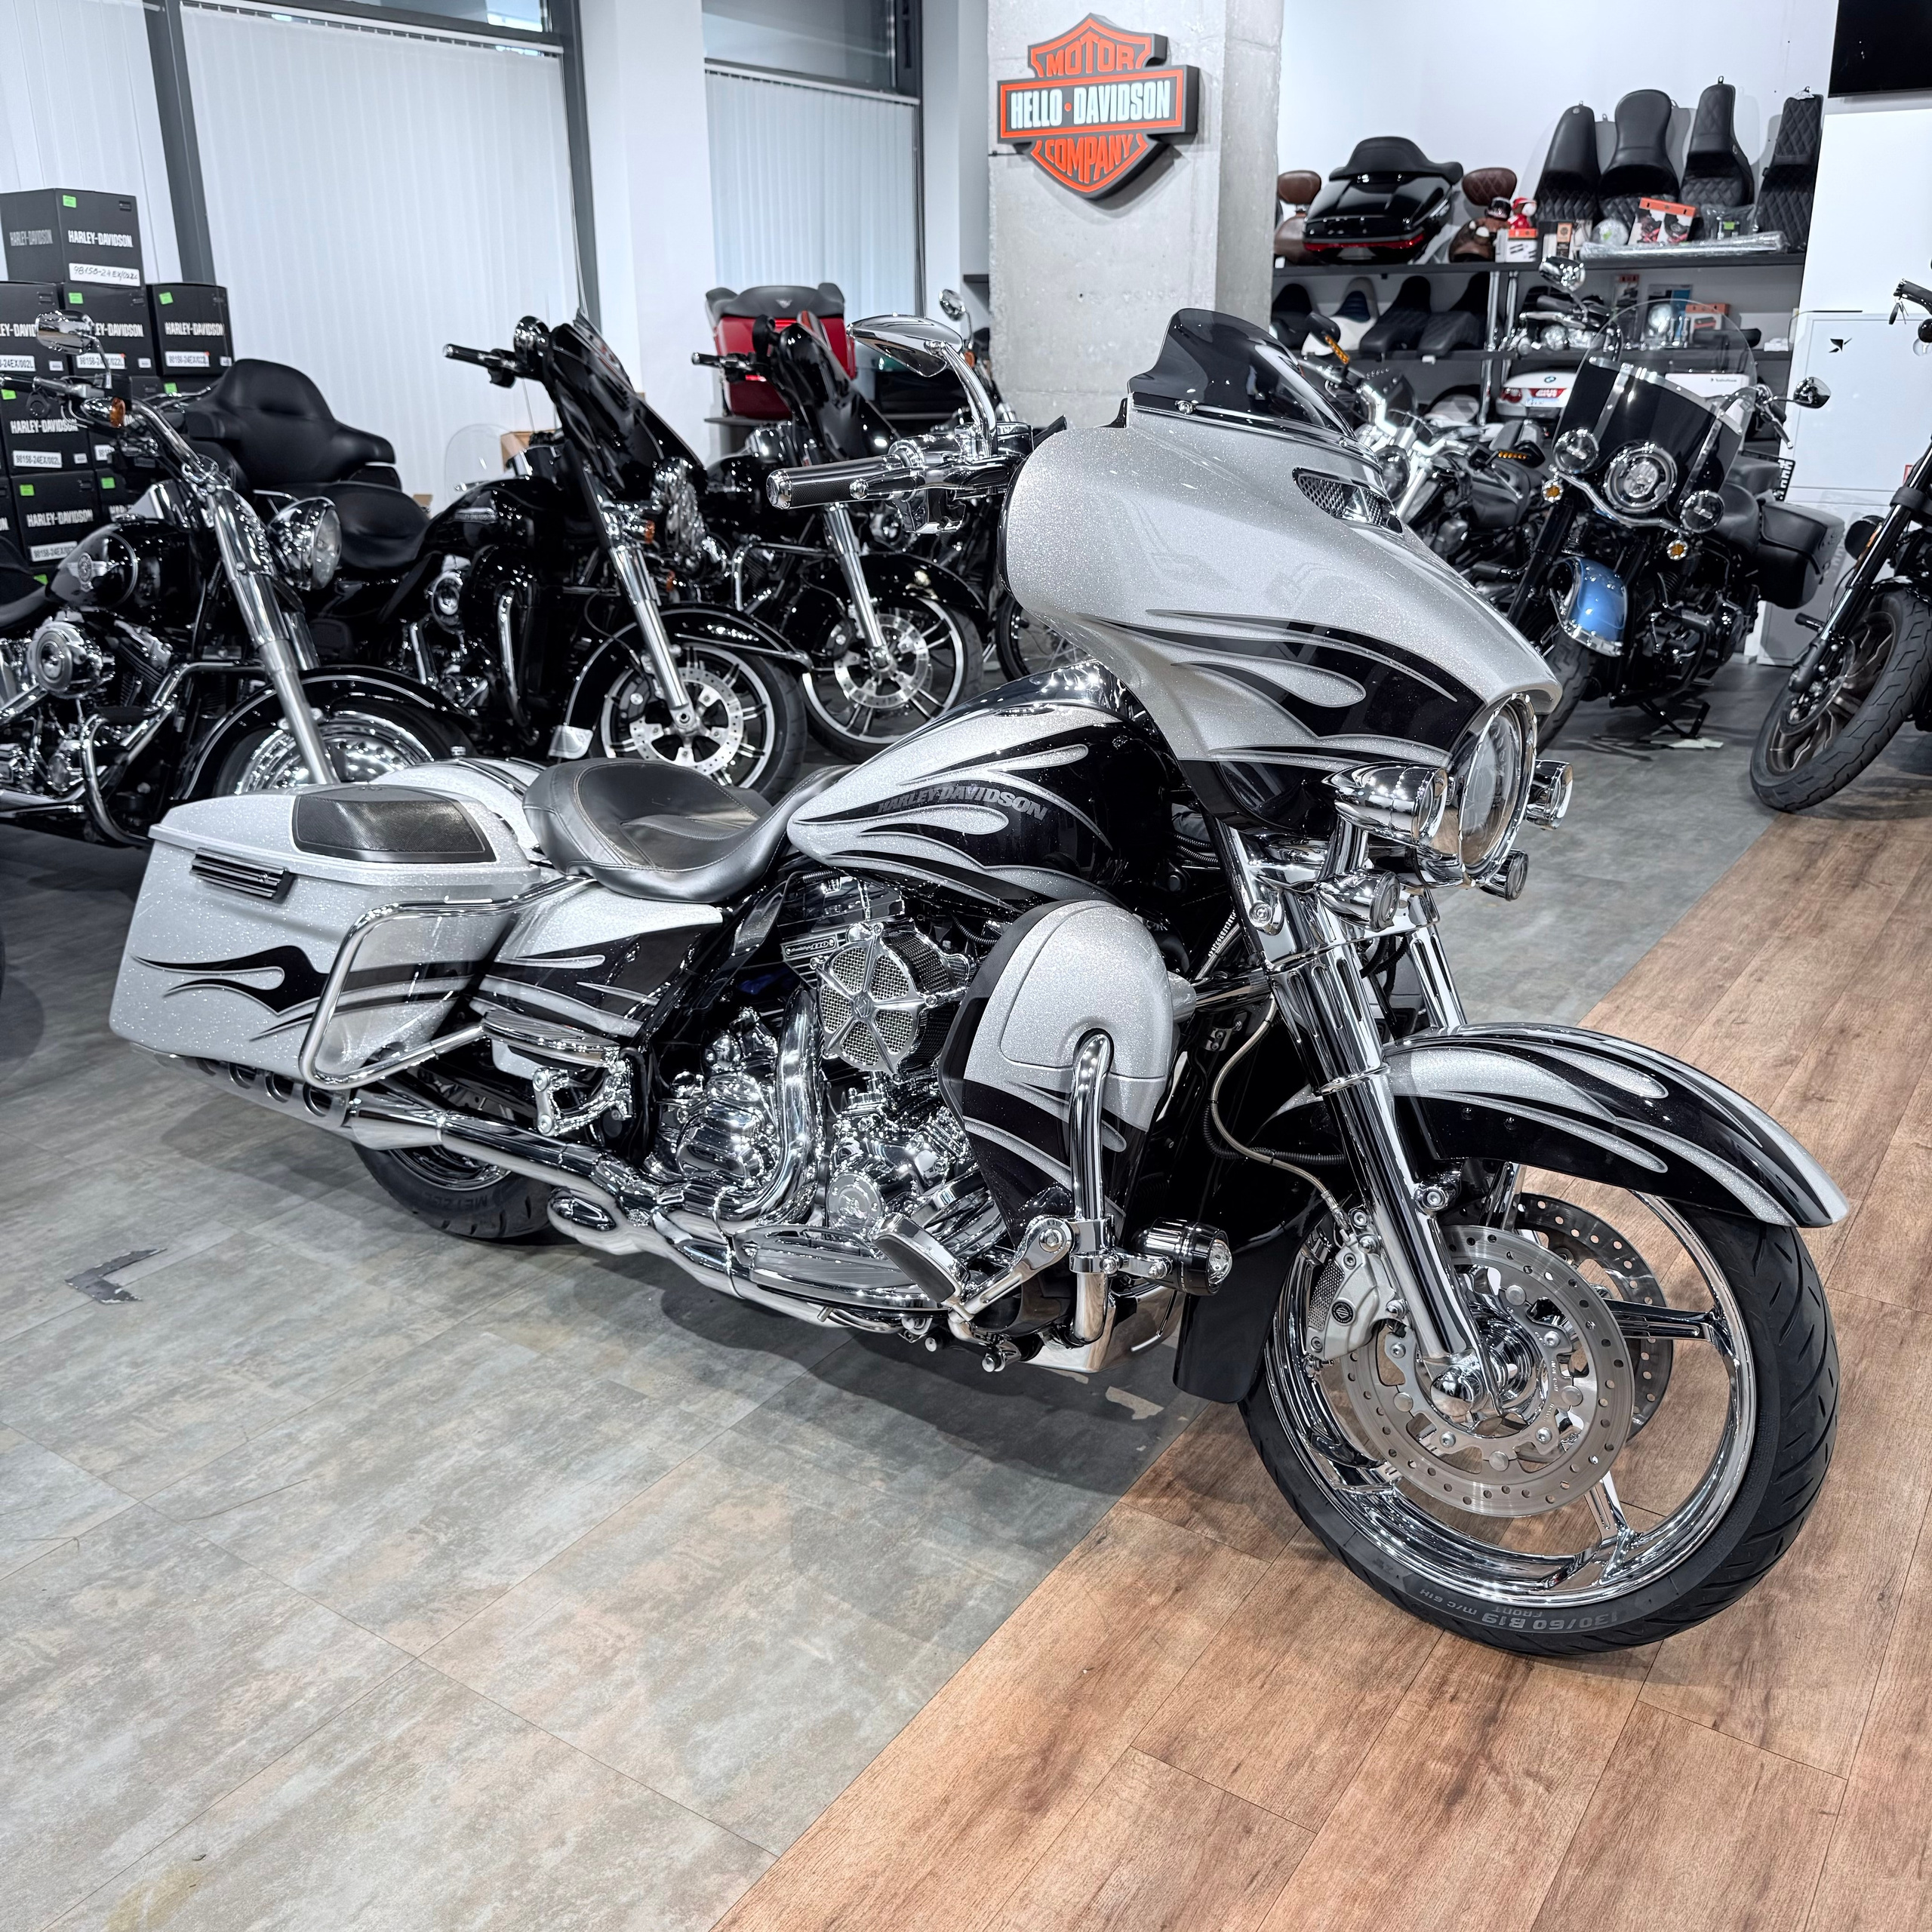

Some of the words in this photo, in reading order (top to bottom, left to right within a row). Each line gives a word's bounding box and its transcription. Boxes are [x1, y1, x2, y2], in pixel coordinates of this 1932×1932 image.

[1046, 30, 1134, 77] MOTOR
[1011, 88, 1063, 129] HELLO
[1073, 80, 1170, 125] DAVIDSON
[1044, 134, 1134, 184] COMPANY
[9, 229, 54, 247] HARLEY-DAVIDSON
[68, 229, 134, 248] HARLEY-DAVIDSON
[164, 321, 225, 337] HARLEY-DAVIDSON
[10, 418, 79, 434] HARLEY-DAVIDSON
[26, 509, 94, 528] HARLEY-DAVIDSON
[1481, 1612, 1526, 1629] B19
[1491, 1605, 1543, 1618] FRONT
[1532, 1611, 1618, 1631] 130/60
